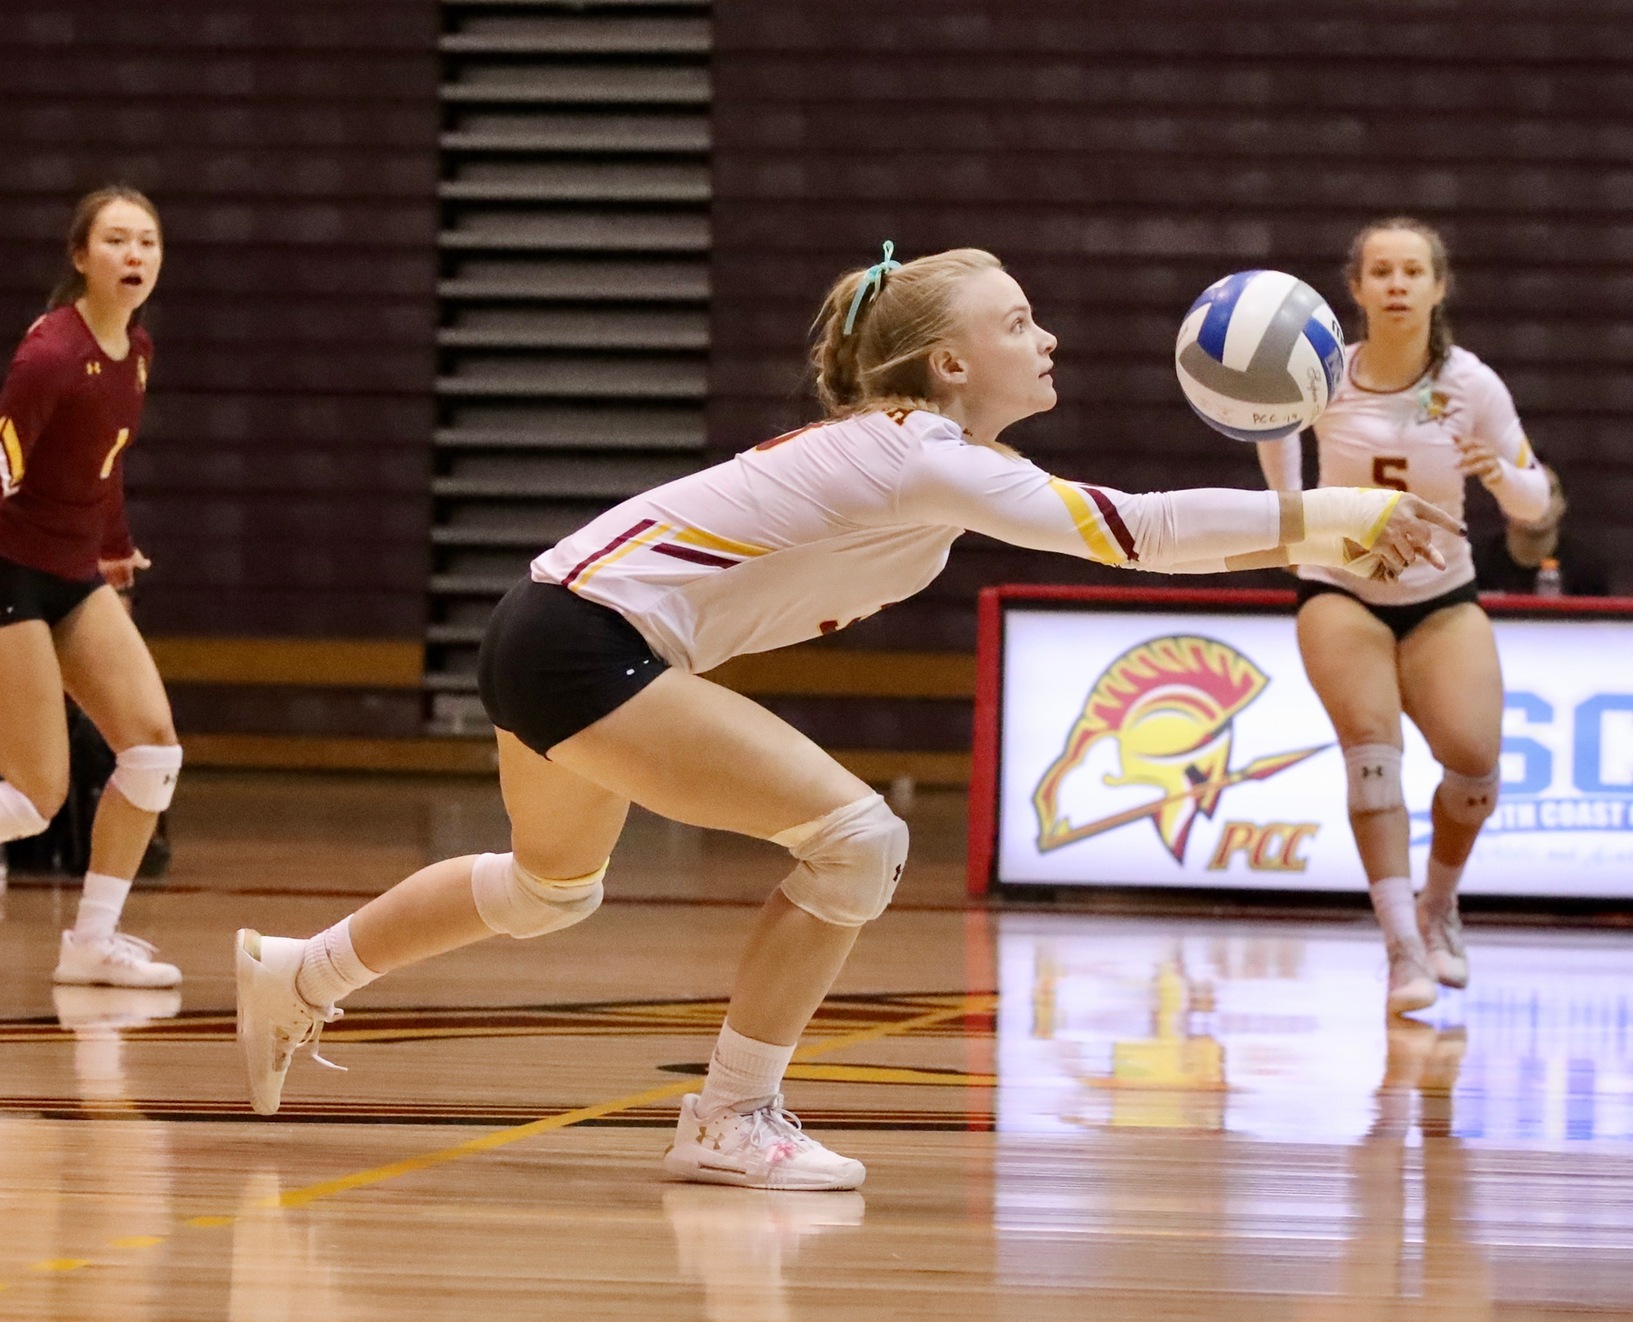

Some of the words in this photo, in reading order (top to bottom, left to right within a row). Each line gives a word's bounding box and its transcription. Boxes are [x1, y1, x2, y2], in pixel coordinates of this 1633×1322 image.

[100, 427, 129, 479] 1
[1372, 456, 1408, 492] 5
[1539, 800, 1623, 828] COAST
[1206, 821, 1319, 872] PCC
